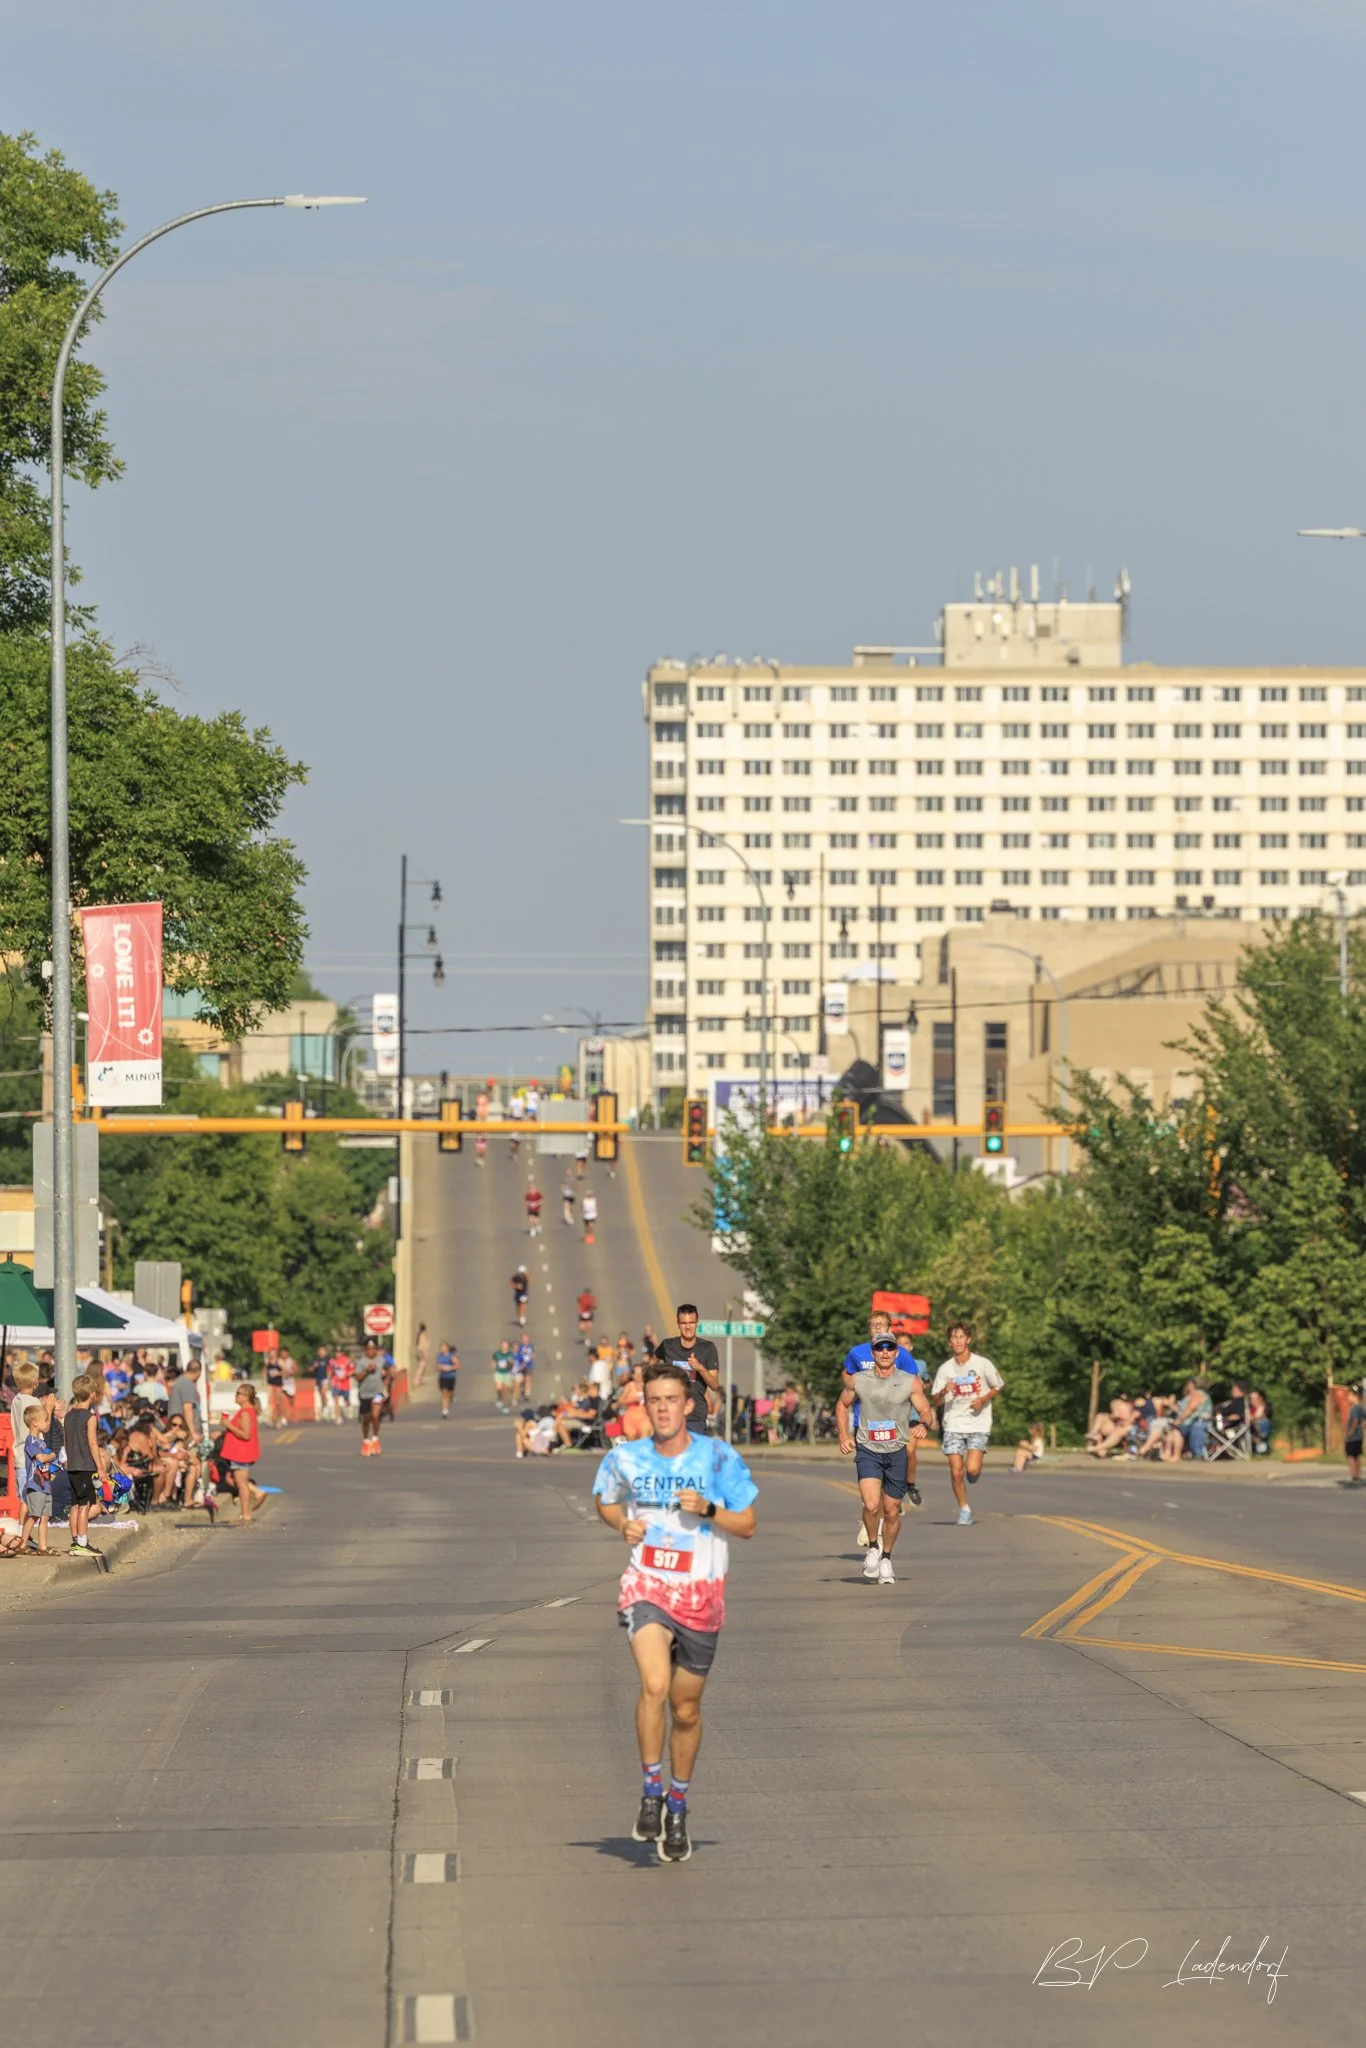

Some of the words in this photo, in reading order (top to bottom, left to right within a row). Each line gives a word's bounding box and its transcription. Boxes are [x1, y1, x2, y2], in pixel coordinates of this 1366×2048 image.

[113, 923, 134, 990] LOVE
[117, 996, 136, 1028] IT!
[125, 1072, 160, 1081] MINOT
[874, 1430, 890, 1441] 588
[632, 1476, 706, 1490] CENTRAL
[653, 1549, 680, 1570] 517
